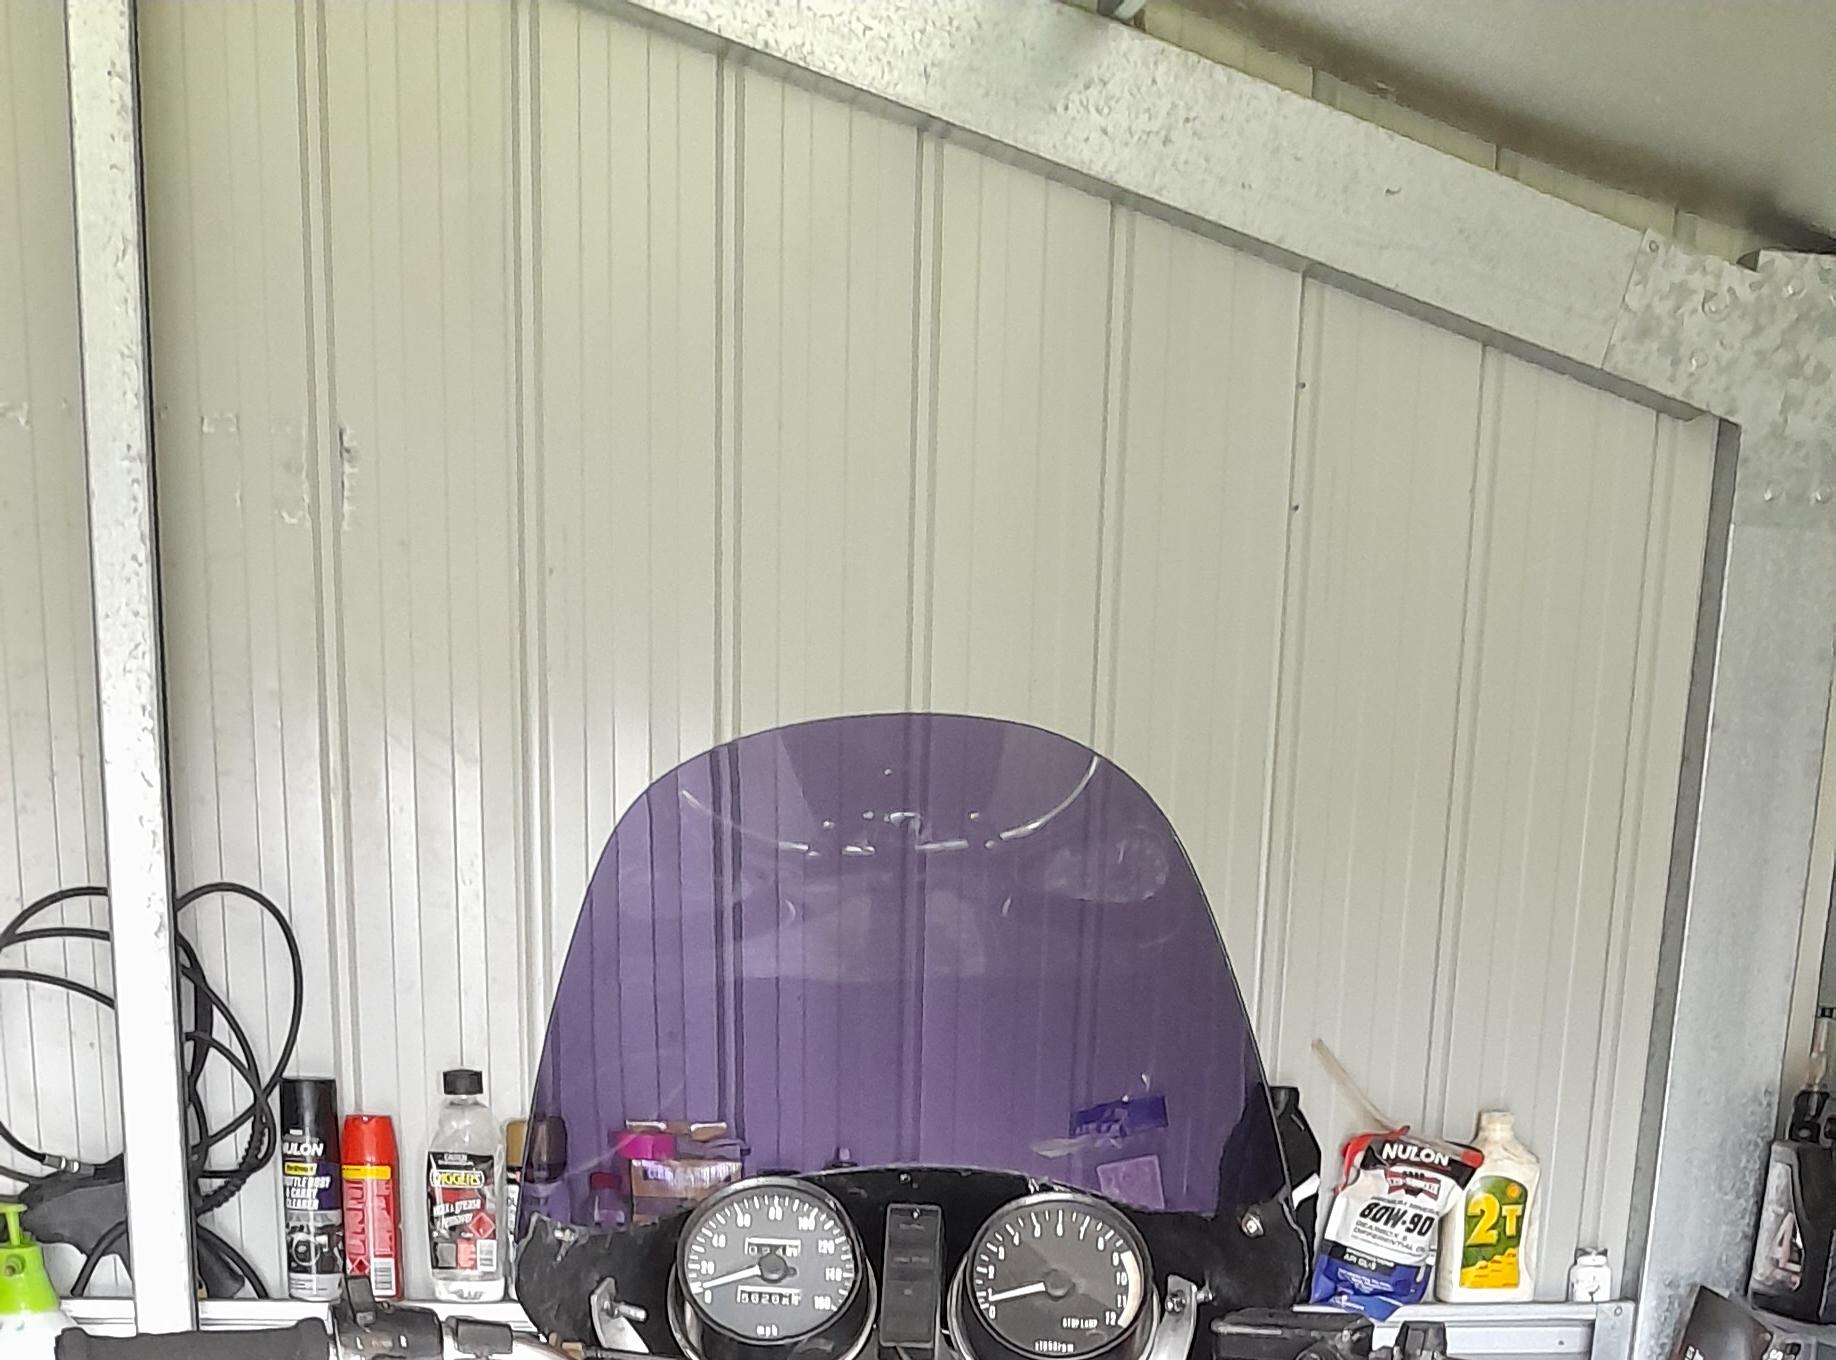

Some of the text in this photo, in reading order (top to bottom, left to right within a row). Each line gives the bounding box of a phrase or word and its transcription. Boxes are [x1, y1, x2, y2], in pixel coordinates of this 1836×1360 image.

[1382, 1142, 1450, 1167] NULON
[1466, 1193, 1524, 1246] 2T
[712, 1233, 726, 1248] 40
[701, 1261, 715, 1275] 20
[1105, 1311, 1117, 1326] 12
[756, 1323, 778, 1337] mph
